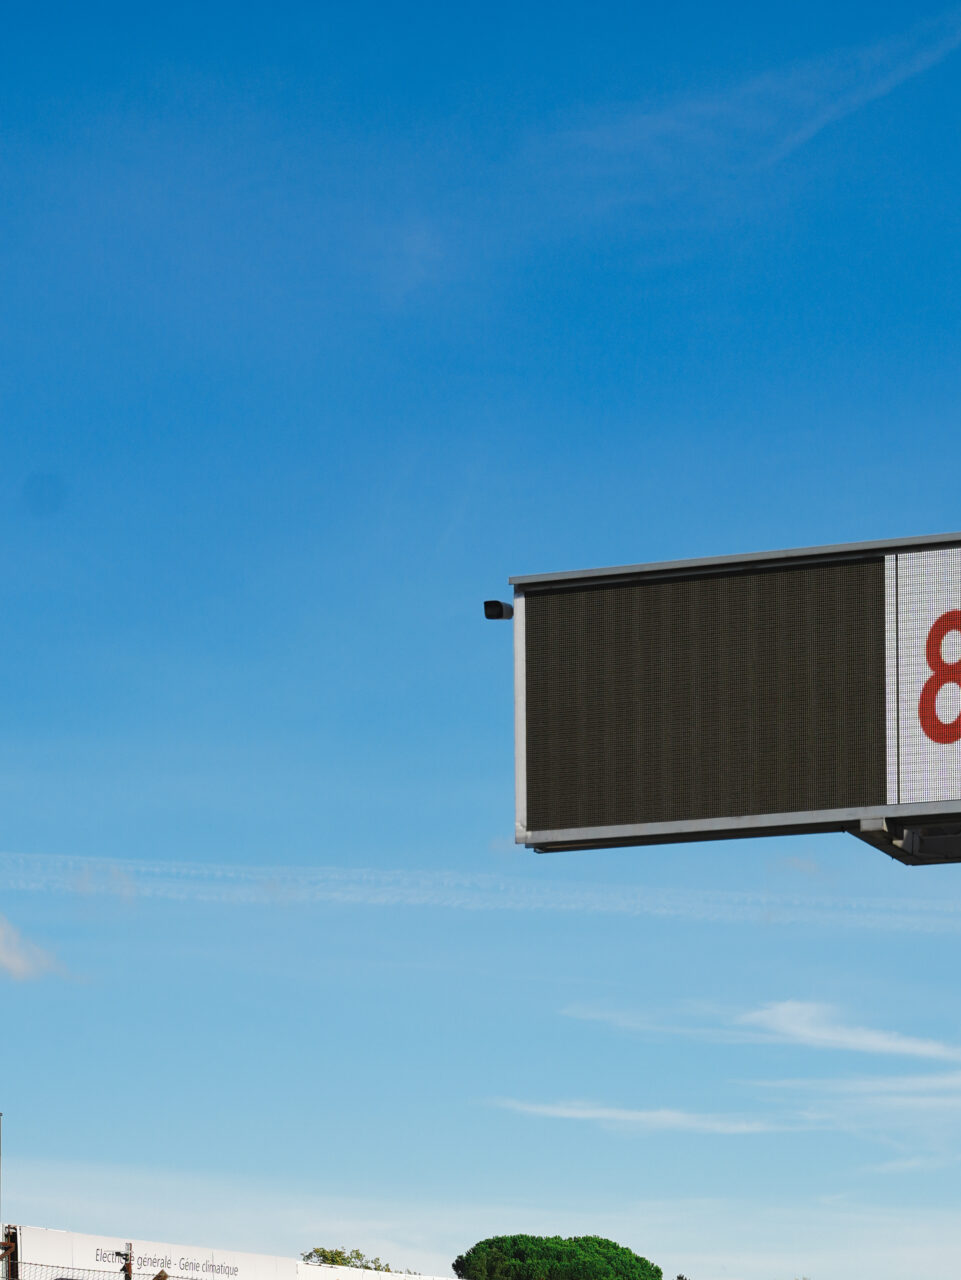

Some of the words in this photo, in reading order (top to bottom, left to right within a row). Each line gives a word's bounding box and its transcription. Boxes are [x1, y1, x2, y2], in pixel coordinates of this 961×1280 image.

[137, 1253, 172, 1270] générale
[179, 1257, 200, 1272] Génie
[201, 1261, 239, 1278] climatique
